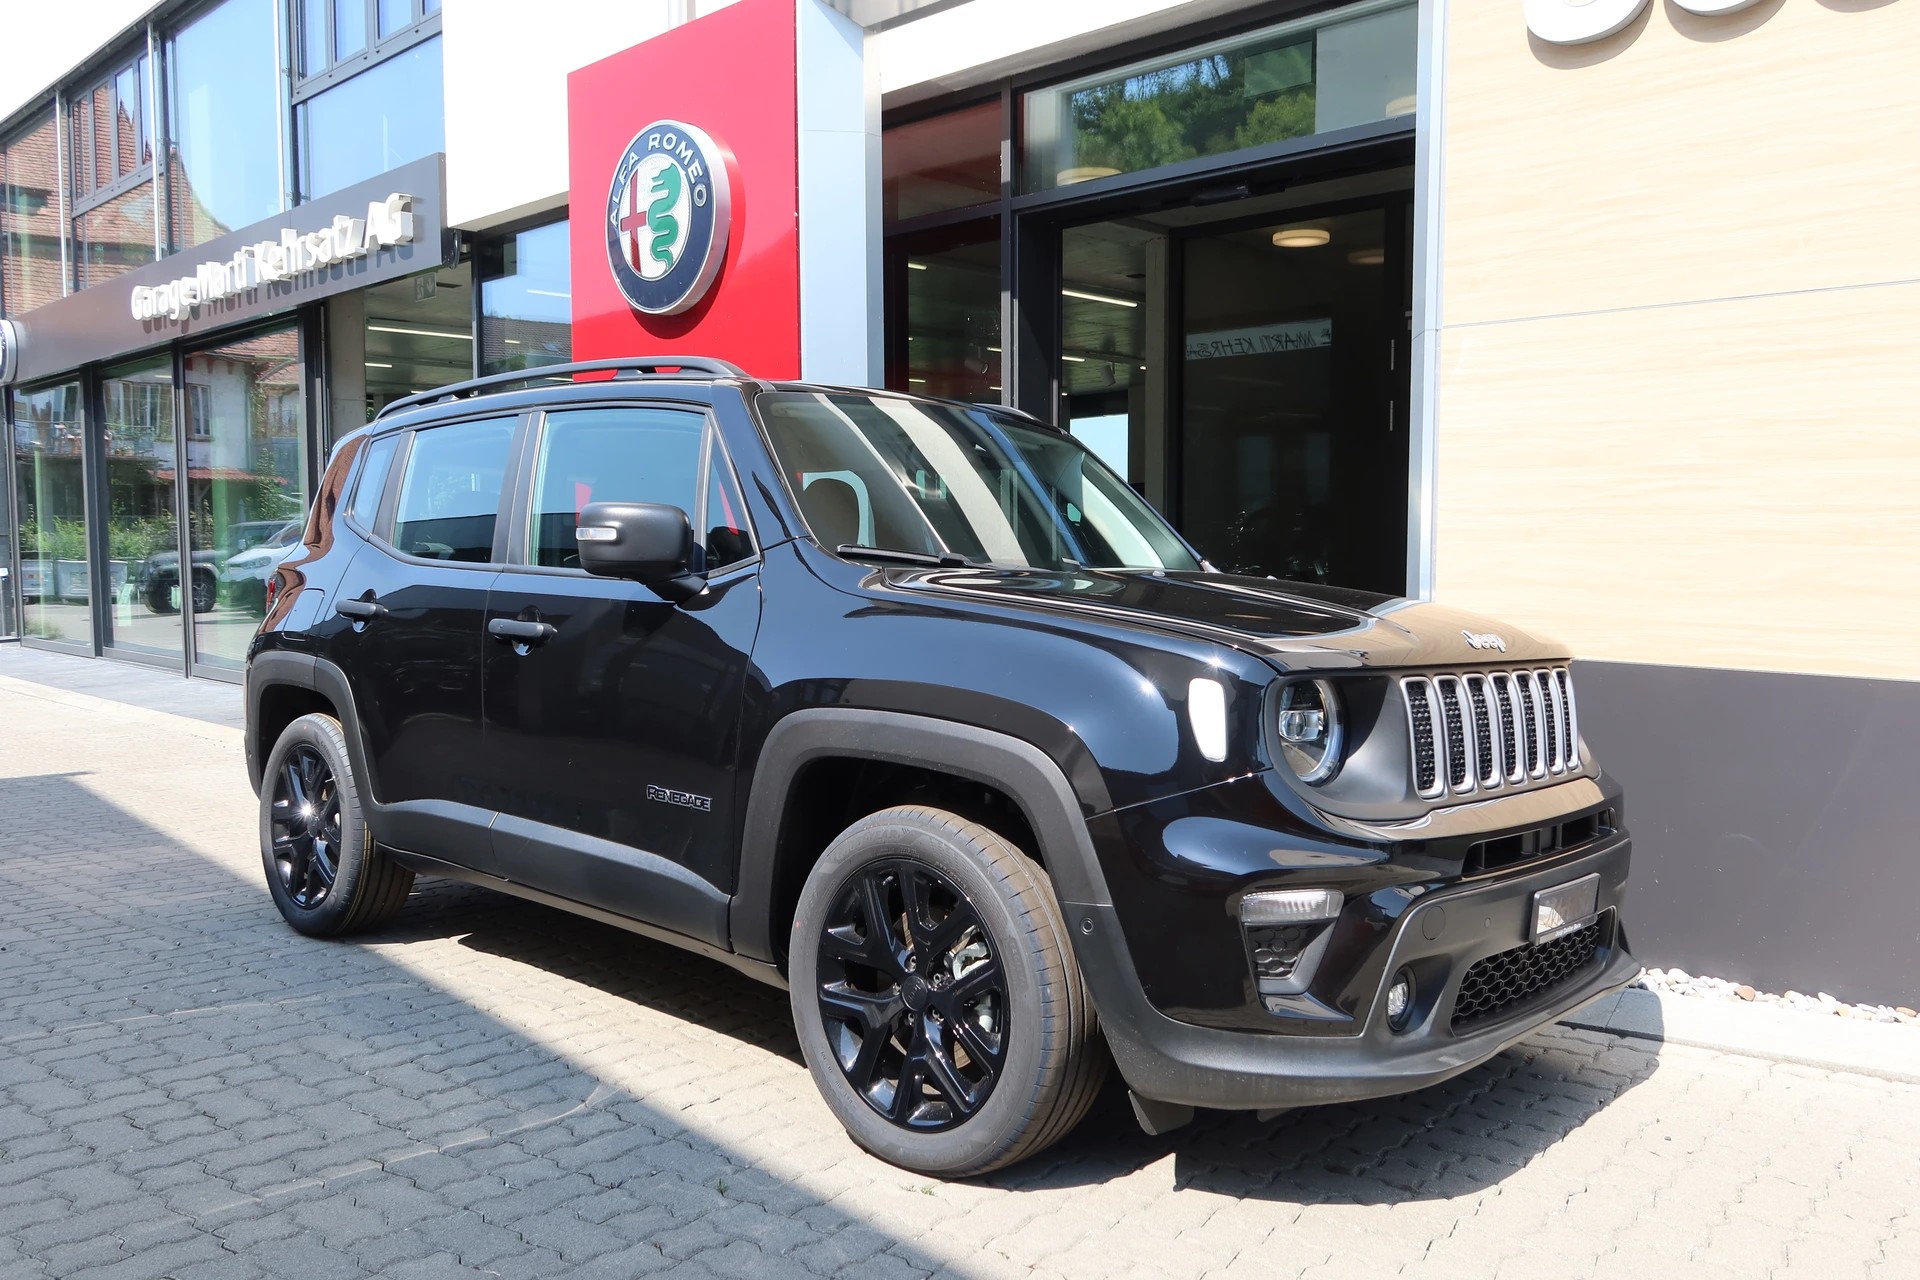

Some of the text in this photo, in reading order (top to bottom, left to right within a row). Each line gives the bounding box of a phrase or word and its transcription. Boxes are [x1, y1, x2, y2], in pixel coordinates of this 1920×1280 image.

[610, 132, 708, 230] ALFA ROMEO
[130, 192, 415, 321] Garage Marti Kehrsatz AG
[1461, 629, 1507, 654] Jeep
[646, 784, 712, 812] RENEGADE
